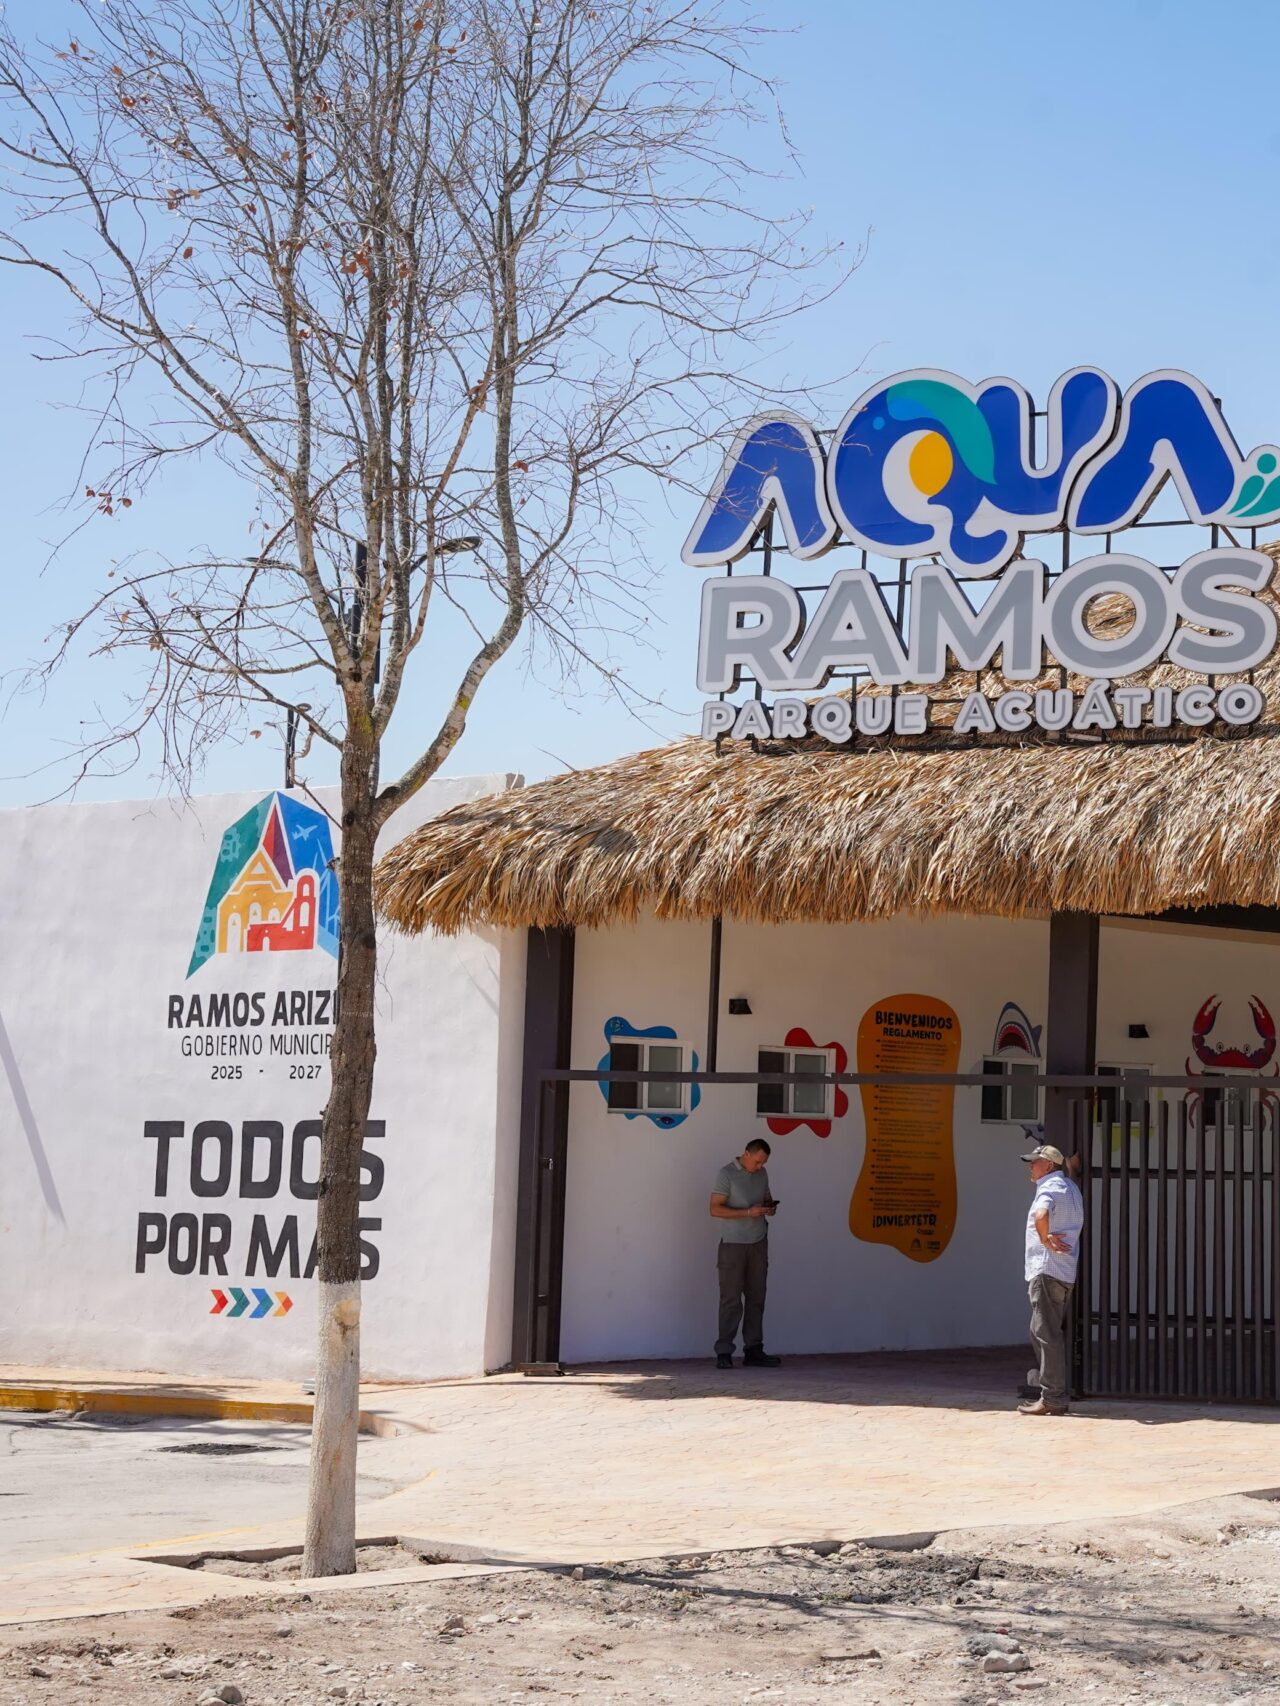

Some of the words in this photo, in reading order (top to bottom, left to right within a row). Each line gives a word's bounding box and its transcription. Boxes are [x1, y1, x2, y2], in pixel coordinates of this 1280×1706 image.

[680, 366, 1245, 578] AQUA
[696, 547, 1280, 693] RAMOS
[700, 693, 928, 744] PARQUE
[954, 679, 1265, 734] ACUÁTICO
[168, 992, 265, 1028] RAMOS
[272, 990, 339, 1026] ARIZ
[875, 1010, 953, 1030] BIENVENIDOS
[181, 1034, 262, 1057] GOBIERNO
[270, 1034, 333, 1055] MUNICIP
[883, 1028, 942, 1041] REGLAMENTO
[211, 1065, 243, 1080] 2025
[289, 1065, 322, 1080] 2027
[135, 1212, 232, 1276] POR
[245, 1214, 382, 1281] MS
